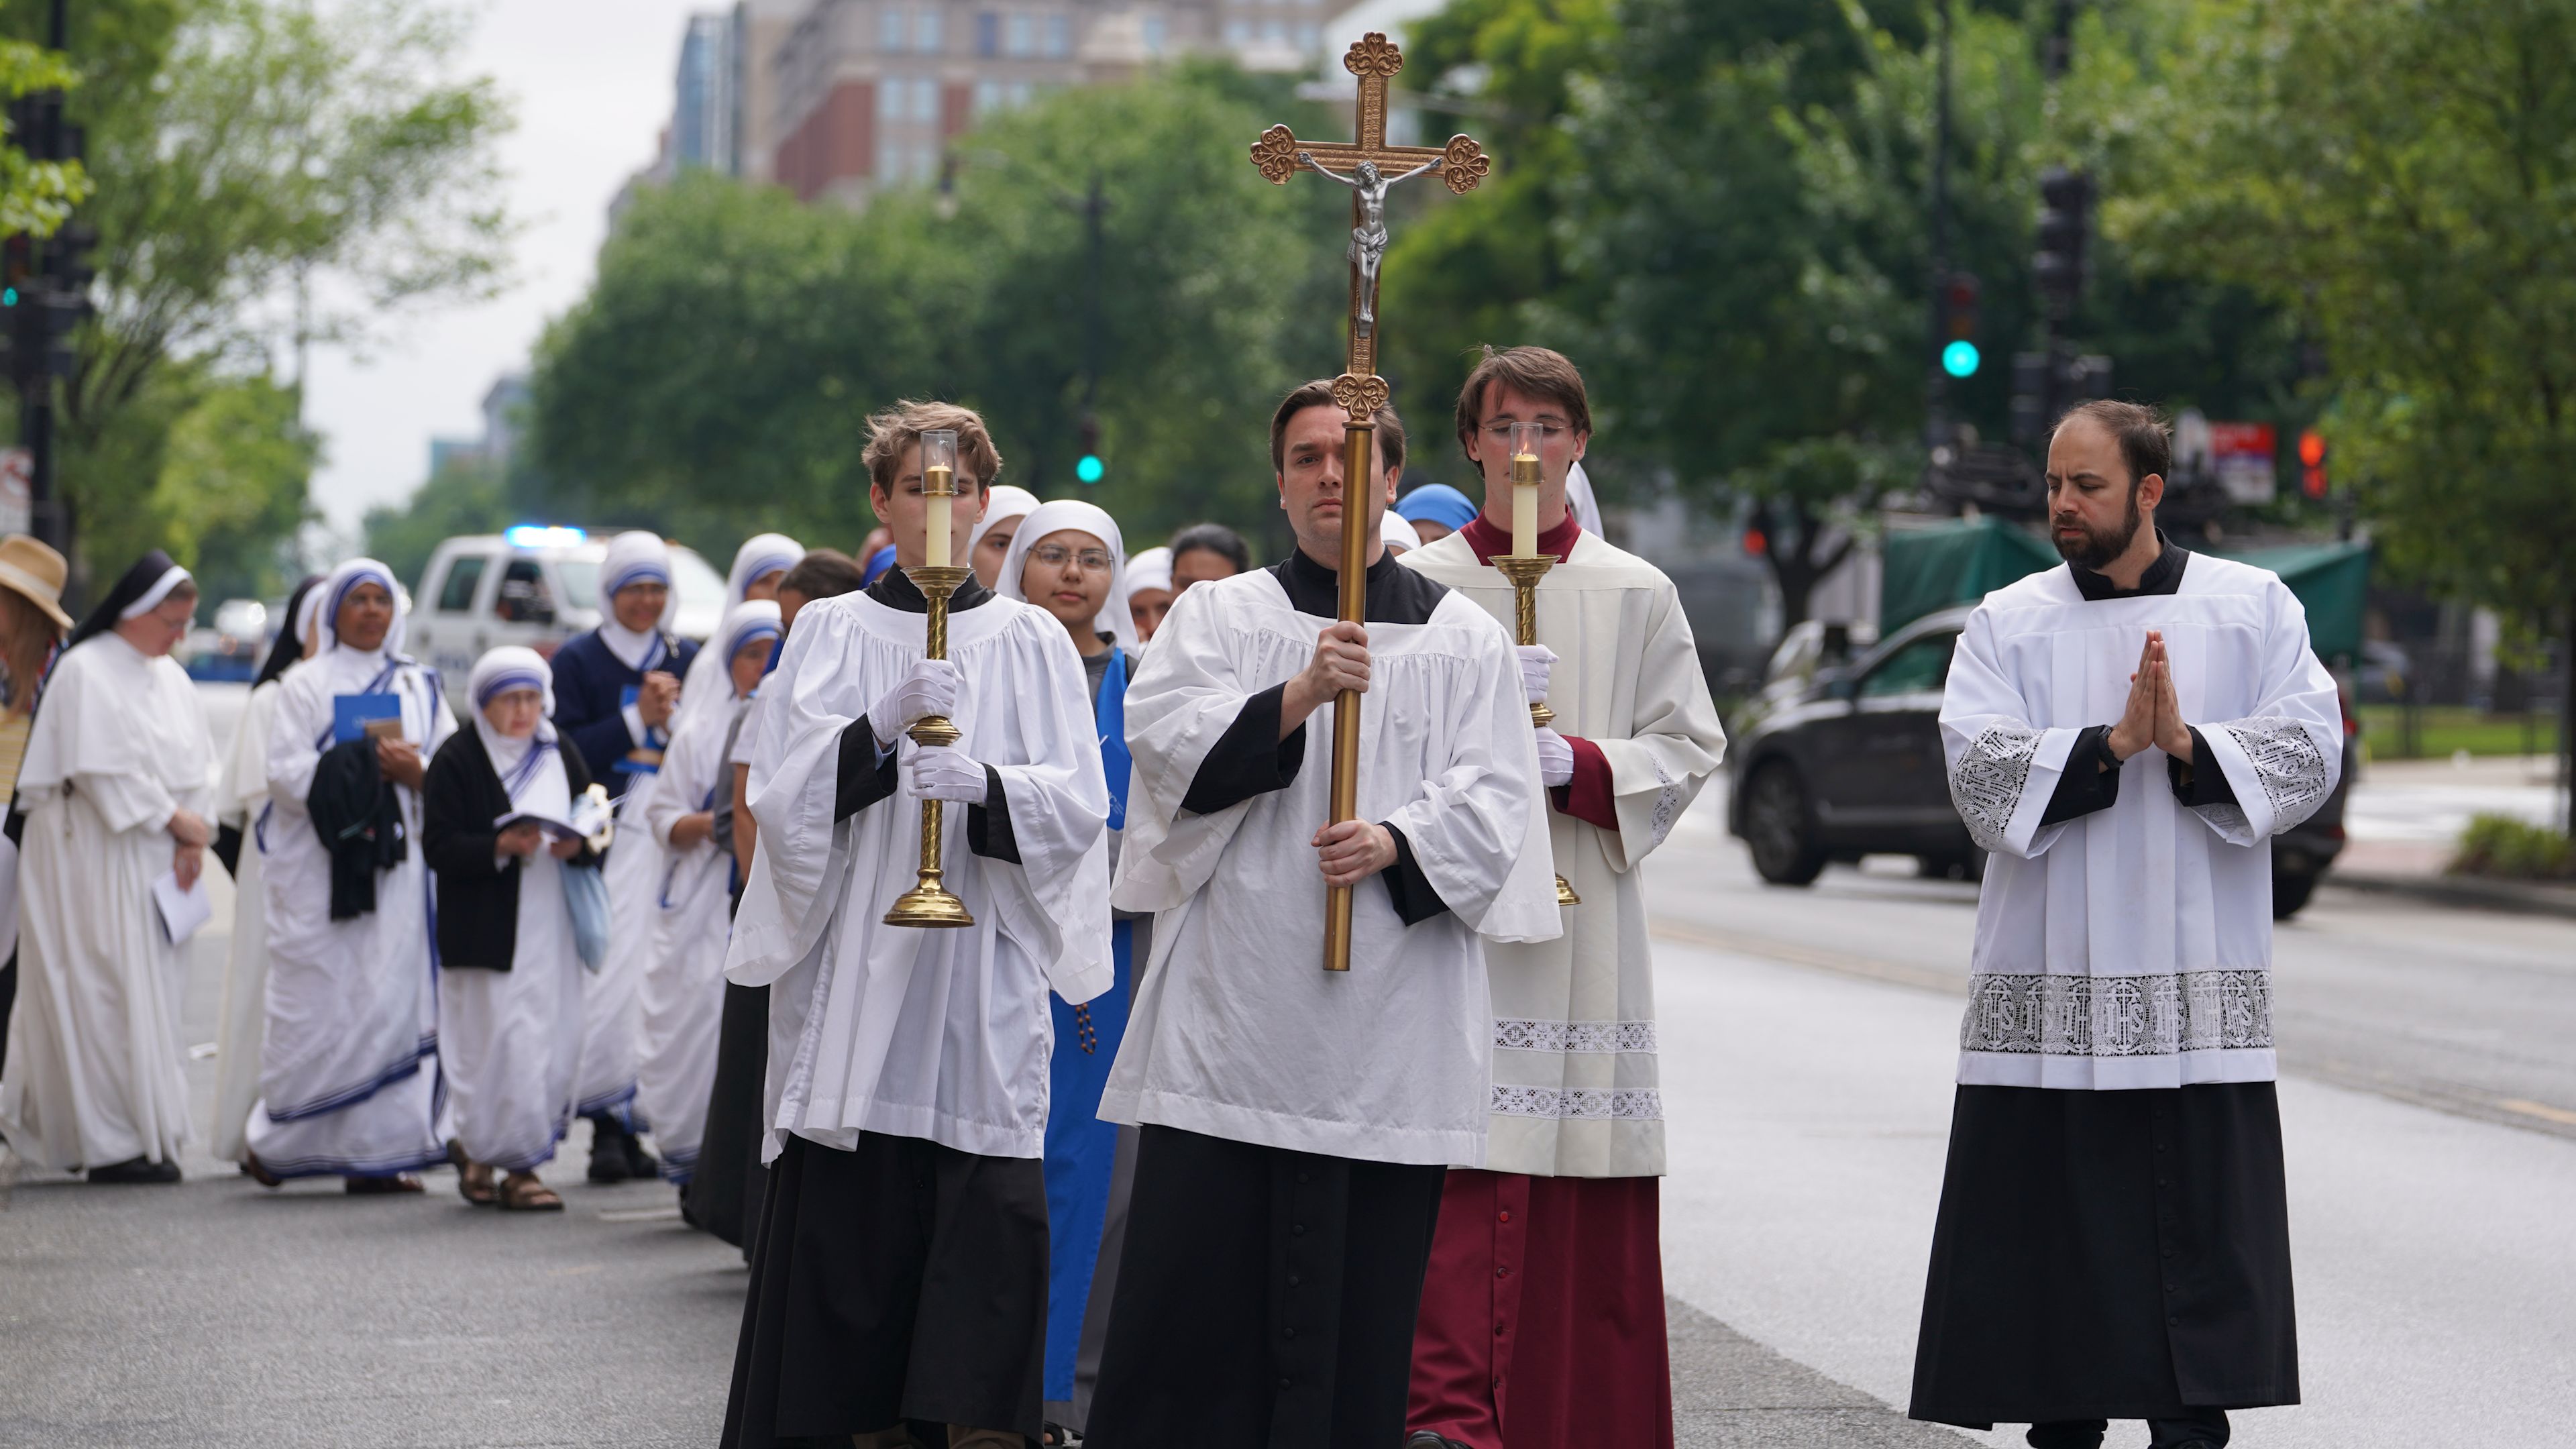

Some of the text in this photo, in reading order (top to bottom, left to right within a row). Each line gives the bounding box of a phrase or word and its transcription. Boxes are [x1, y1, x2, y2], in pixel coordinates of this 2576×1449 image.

[1970, 764, 2012, 805] IHS
[1979, 998, 2013, 1039] IHS
[2106, 1000, 2143, 1044] IHS
[2222, 995, 2252, 1037] IHS
